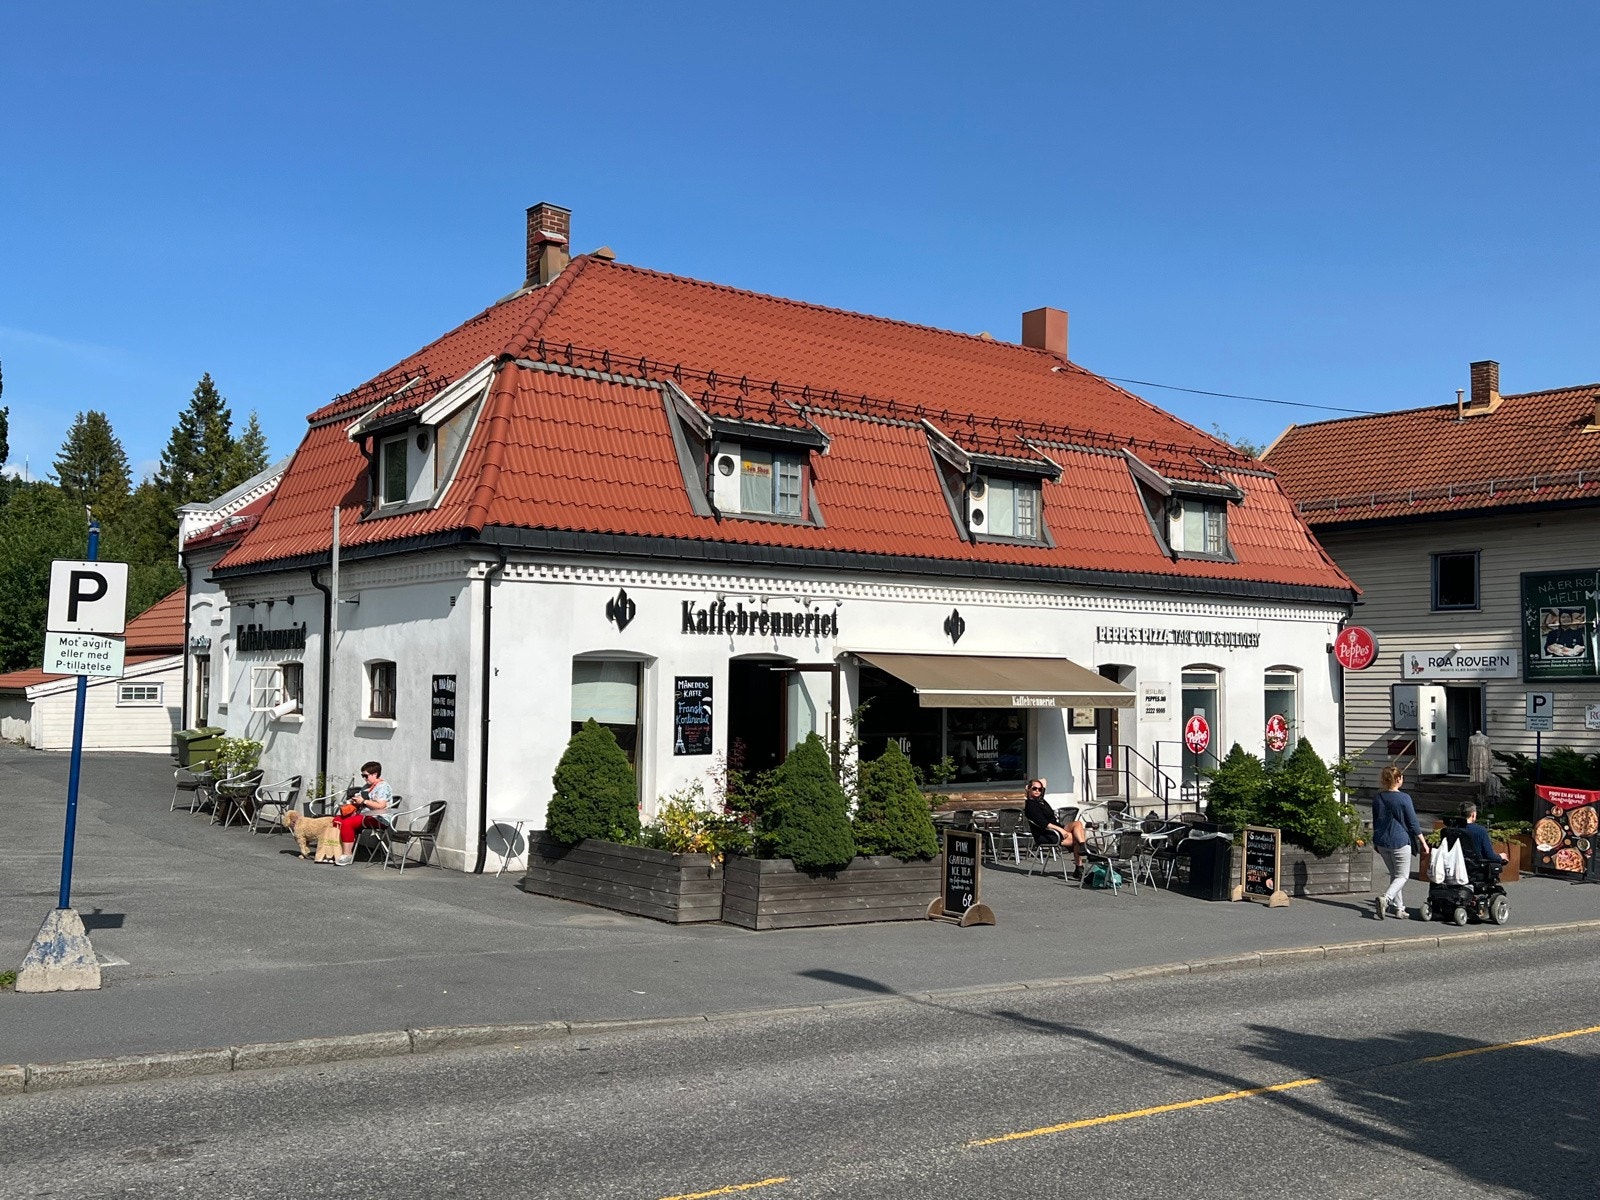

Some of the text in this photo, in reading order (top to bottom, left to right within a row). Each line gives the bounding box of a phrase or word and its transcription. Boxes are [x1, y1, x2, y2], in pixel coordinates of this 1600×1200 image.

[1538, 578, 1598, 593] NÅ ER RØ
[67, 570, 108, 622] P
[1548, 590, 1582, 605] HELT
[681, 600, 838, 637] Kaffebrenneriet
[1097, 626, 1139, 643] PEPPES
[1140, 628, 1171, 645] PIZZA
[59, 638, 112, 650] Mot avgift
[1339, 642, 1370, 658] Peppes
[60, 650, 108, 660] eller med
[1428, 656, 1510, 668] RØA RØVER'N
[56, 660, 111, 671] P-tillatelse
[678, 680, 709, 690] MÅNEDENS
[684, 690, 702, 698] KAFFE
[1011, 695, 1055, 706] Kaffebrenneriet
[678, 701, 704, 715] Fransk
[1533, 695, 1546, 713] P
[976, 735, 999, 750] Kaffe
[955, 840, 969, 854] PINK
[951, 866, 972, 877] ICE TEA
